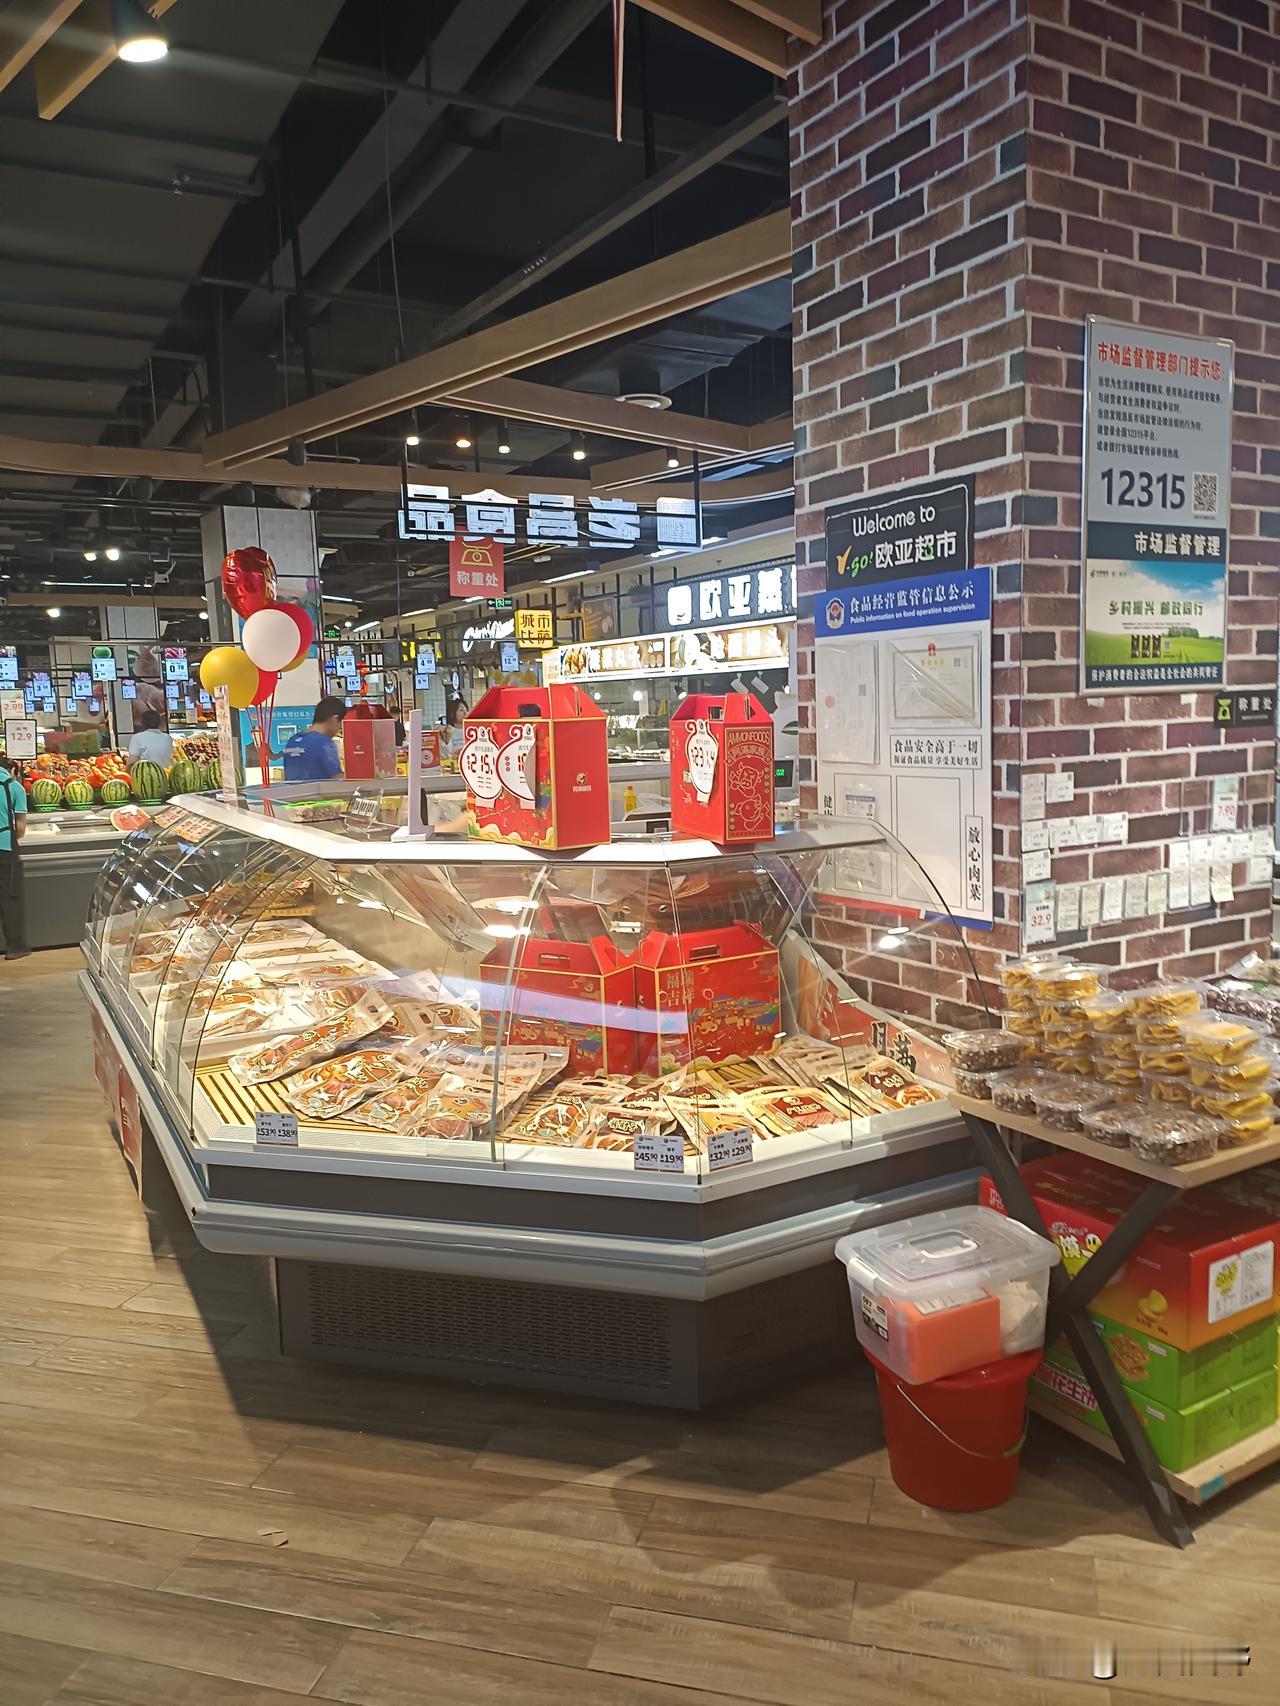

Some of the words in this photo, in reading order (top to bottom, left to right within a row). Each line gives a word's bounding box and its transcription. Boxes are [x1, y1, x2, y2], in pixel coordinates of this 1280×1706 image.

[1101, 467, 1186, 510] 12315
[853, 512, 916, 537] Welcome
[919, 505, 936, 523] to
[875, 530, 957, 569] 欧亚超市
[1134, 531, 1221, 557] 市场监督管理
[456, 570, 498, 587] 称重处
[850, 580, 974, 614] 食品经营监管信息公示
[850, 613, 865, 624] Public
[895, 611, 903, 619] on
[903, 609, 915, 618] food
[916, 606, 942, 618] operation
[943, 603, 975, 615] supervision
[1109, 600, 1155, 615] 乡村振兴
[520, 613, 550, 629] 城市
[1238, 696, 1273, 712] 称重处
[11, 733, 32, 741] 12.9
[895, 739, 978, 754] 食品安全高于一切
[894, 754, 933, 765] 保证食品质量
[936, 755, 978, 766] 享受美好生活
[1031, 912, 1052, 928] 32.9
